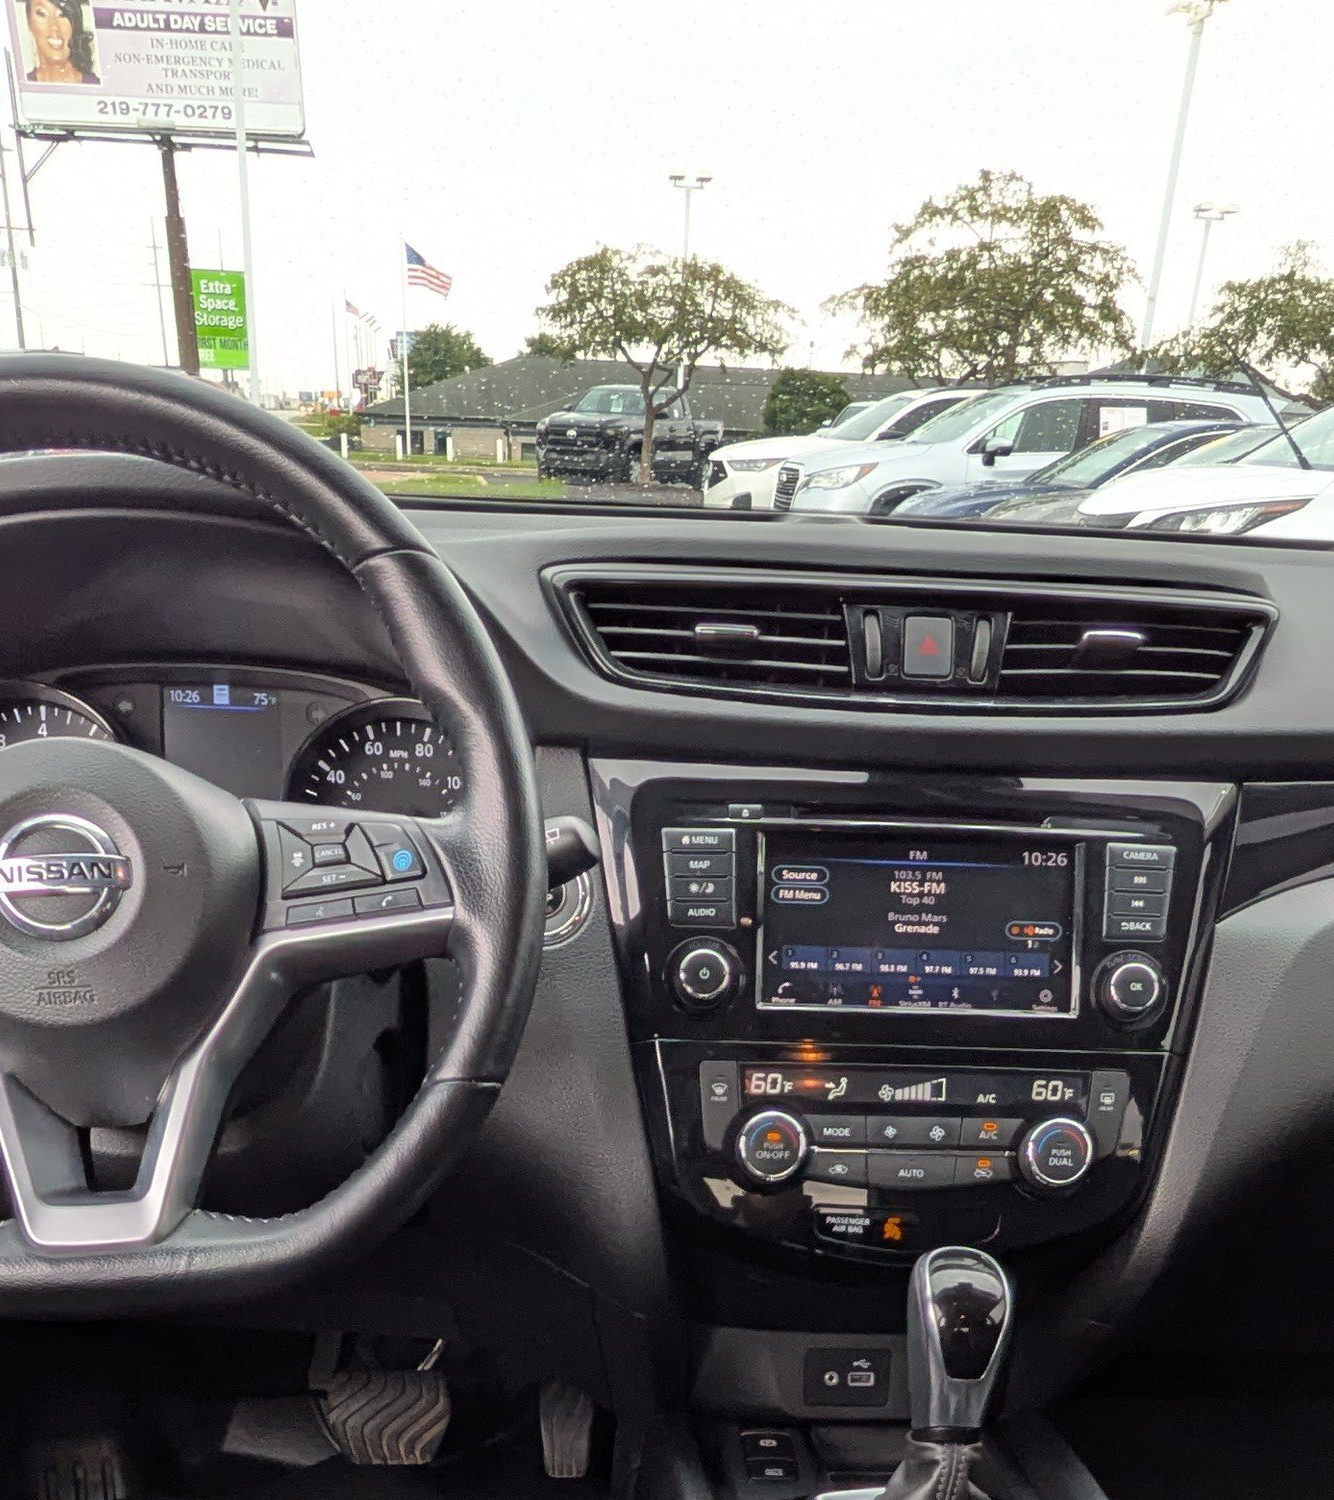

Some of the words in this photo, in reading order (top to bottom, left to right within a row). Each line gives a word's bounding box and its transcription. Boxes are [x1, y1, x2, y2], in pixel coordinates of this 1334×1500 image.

[113, 12, 166, 28] ADULT
[170, 14, 201, 31] DAY
[150, 38, 207, 51] IN-HOME
[210, 42, 245, 54] CA
[114, 53, 224, 68] NON-EMERGENCY
[146, 84, 174, 94] AND
[177, 84, 215, 96] MUCH
[96, 101, 233, 121] 219-777-0279
[199, 279, 232, 294] Extra
[199, 294, 236, 312] Space
[194, 311, 244, 329] Storage
[169, 690, 200, 703] 10:26
[37, 723, 48, 738] 4
[365, 741, 383, 755] 60
[415, 743, 433, 757] 80
[389, 749, 408, 759] MPH
[326, 770, 345, 784] 40
[418, 779, 431, 787] 140
[311, 823, 328, 831] RES
[691, 836, 718, 845] MENU
[316, 849, 344, 857] CANCEL
[909, 850, 928, 860] FM
[1123, 851, 1158, 861] CAMERA
[1022, 851, 1067, 867] 10:26
[689, 860, 710, 869] MAP
[321, 874, 337, 883] SET
[782, 870, 817, 880] Source
[893, 870, 921, 880] 103.5
[926, 871, 943, 880] FM
[890, 881, 946, 894] KISS-FM
[779, 889, 793, 899] FM
[795, 890, 821, 900] Menu
[900, 895, 920, 907] Top
[922, 896, 936, 906] 40
[687, 908, 716, 917] AUDIO
[887, 912, 919, 922] Bruno
[921, 913, 948, 923] Mars
[894, 923, 940, 934] Grenade
[1129, 922, 1151, 931] BACK
[851, 963, 863, 971] FM
[896, 965, 908, 973] FM
[941, 966, 952, 974] FM
[985, 967, 997, 975] FM
[1029, 969, 1041, 977] FM
[47, 971, 76, 986] SRS
[1130, 983, 1142, 991] OK
[36, 988, 95, 1006] AIRBAG
[976, 1094, 997, 1104] A/C
[823, 1127, 851, 1137] MODE
[979, 1131, 998, 1140] A/C
[1049, 1157, 1074, 1167] DUAL
[898, 1168, 924, 1178] AUTO
[825, 1216, 870, 1226] PASSENGER
[832, 1225, 846, 1233] AIR
[847, 1225, 864, 1233] BAG
